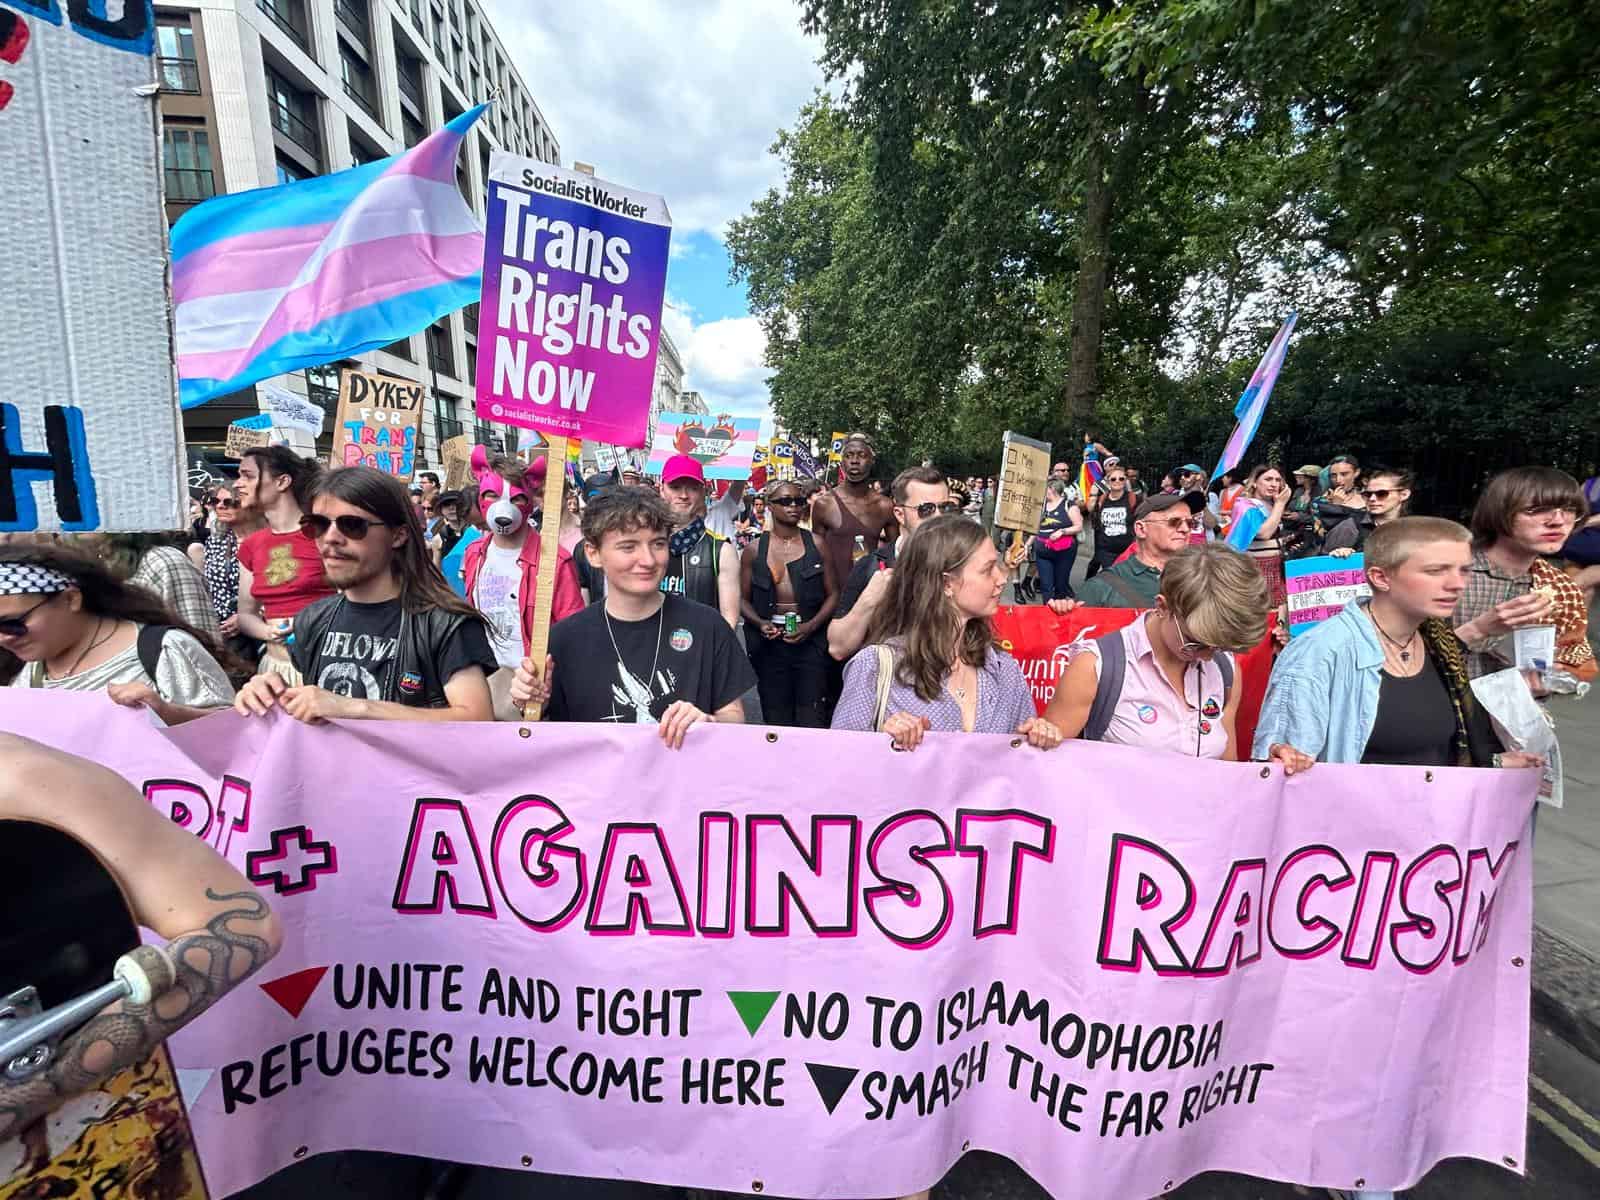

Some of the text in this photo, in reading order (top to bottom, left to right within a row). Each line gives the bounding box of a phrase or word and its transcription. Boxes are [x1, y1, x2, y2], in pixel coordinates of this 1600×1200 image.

[497, 187, 631, 284] Trans
[497, 264, 652, 359] Rights
[349, 373, 420, 411] DYKEY
[493, 335, 596, 413] Now
[344, 421, 416, 451] TRANS
[360, 408, 401, 425] FOR
[504, 408, 582, 430] socialistworker.co.uk
[1295, 572, 1346, 592] TRANS
[393, 794, 1056, 950] AGAINST
[1096, 832, 1520, 978] RACISM
[333, 963, 703, 1037] UNITE AND FIGHT
[783, 980, 1224, 1073] NO TO ISLAMOPHOBIA
[221, 1028, 787, 1114] REFUGEES WELCOME HERE
[863, 1041, 1275, 1138] SMASH THE FAR RIGHT
